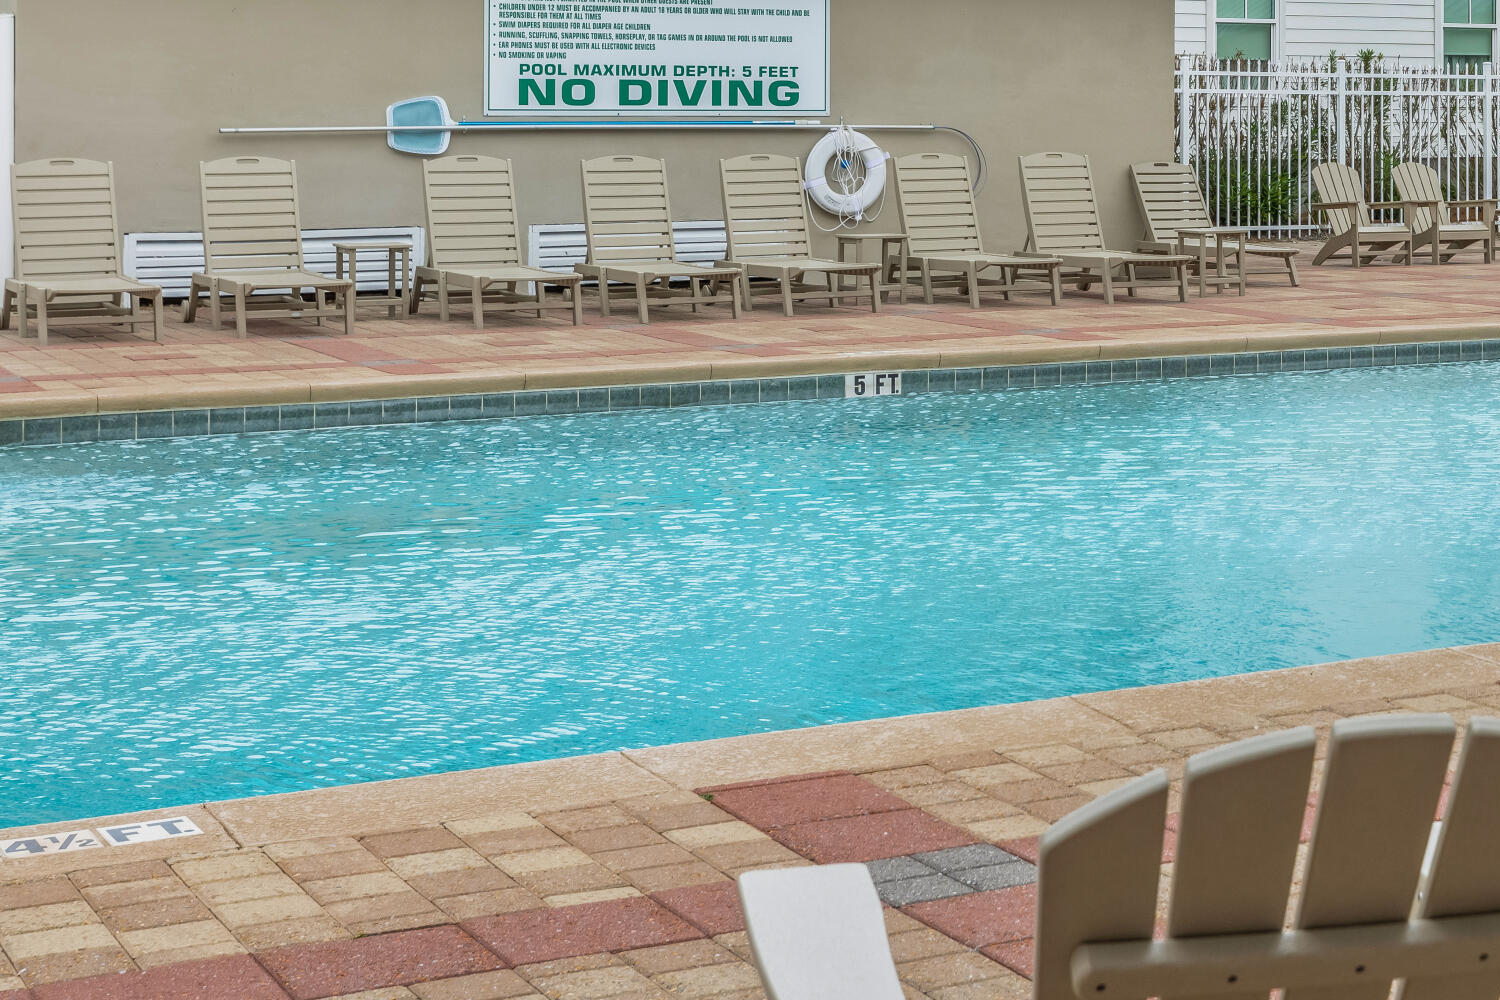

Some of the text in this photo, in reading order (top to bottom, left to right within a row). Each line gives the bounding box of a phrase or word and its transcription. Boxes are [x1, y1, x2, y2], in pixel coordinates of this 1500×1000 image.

[528, 4, 546, 12] UNDER
[548, 4, 555, 12] 12
[556, 4, 572, 12] MUST
[582, 5, 621, 13] ACCOMPANIED
[641, 6, 657, 14] ADULT
[751, 8, 764, 16] WITH
[499, 21, 516, 29] SWIM
[570, 22, 580, 30] FOR
[625, 23, 650, 31] CHILDREN
[561, 32, 589, 40] SNAPPING
[704, 34, 725, 42] AROUND
[770, 35, 792, 43] ALLOWED
[499, 41, 509, 49] EAR
[551, 42, 558, 50] BE
[560, 42, 574, 50] USED
[575, 42, 589, 50] WITH
[634, 43, 655, 51] DEVICES
[520, 63, 799, 78] POOL MAXIMUM DEPTH: 5 FEET
[518, 78, 801, 107] NO DIVING
[854, 373, 899, 396] 5 FT.
[105, 818, 196, 843] FT.
